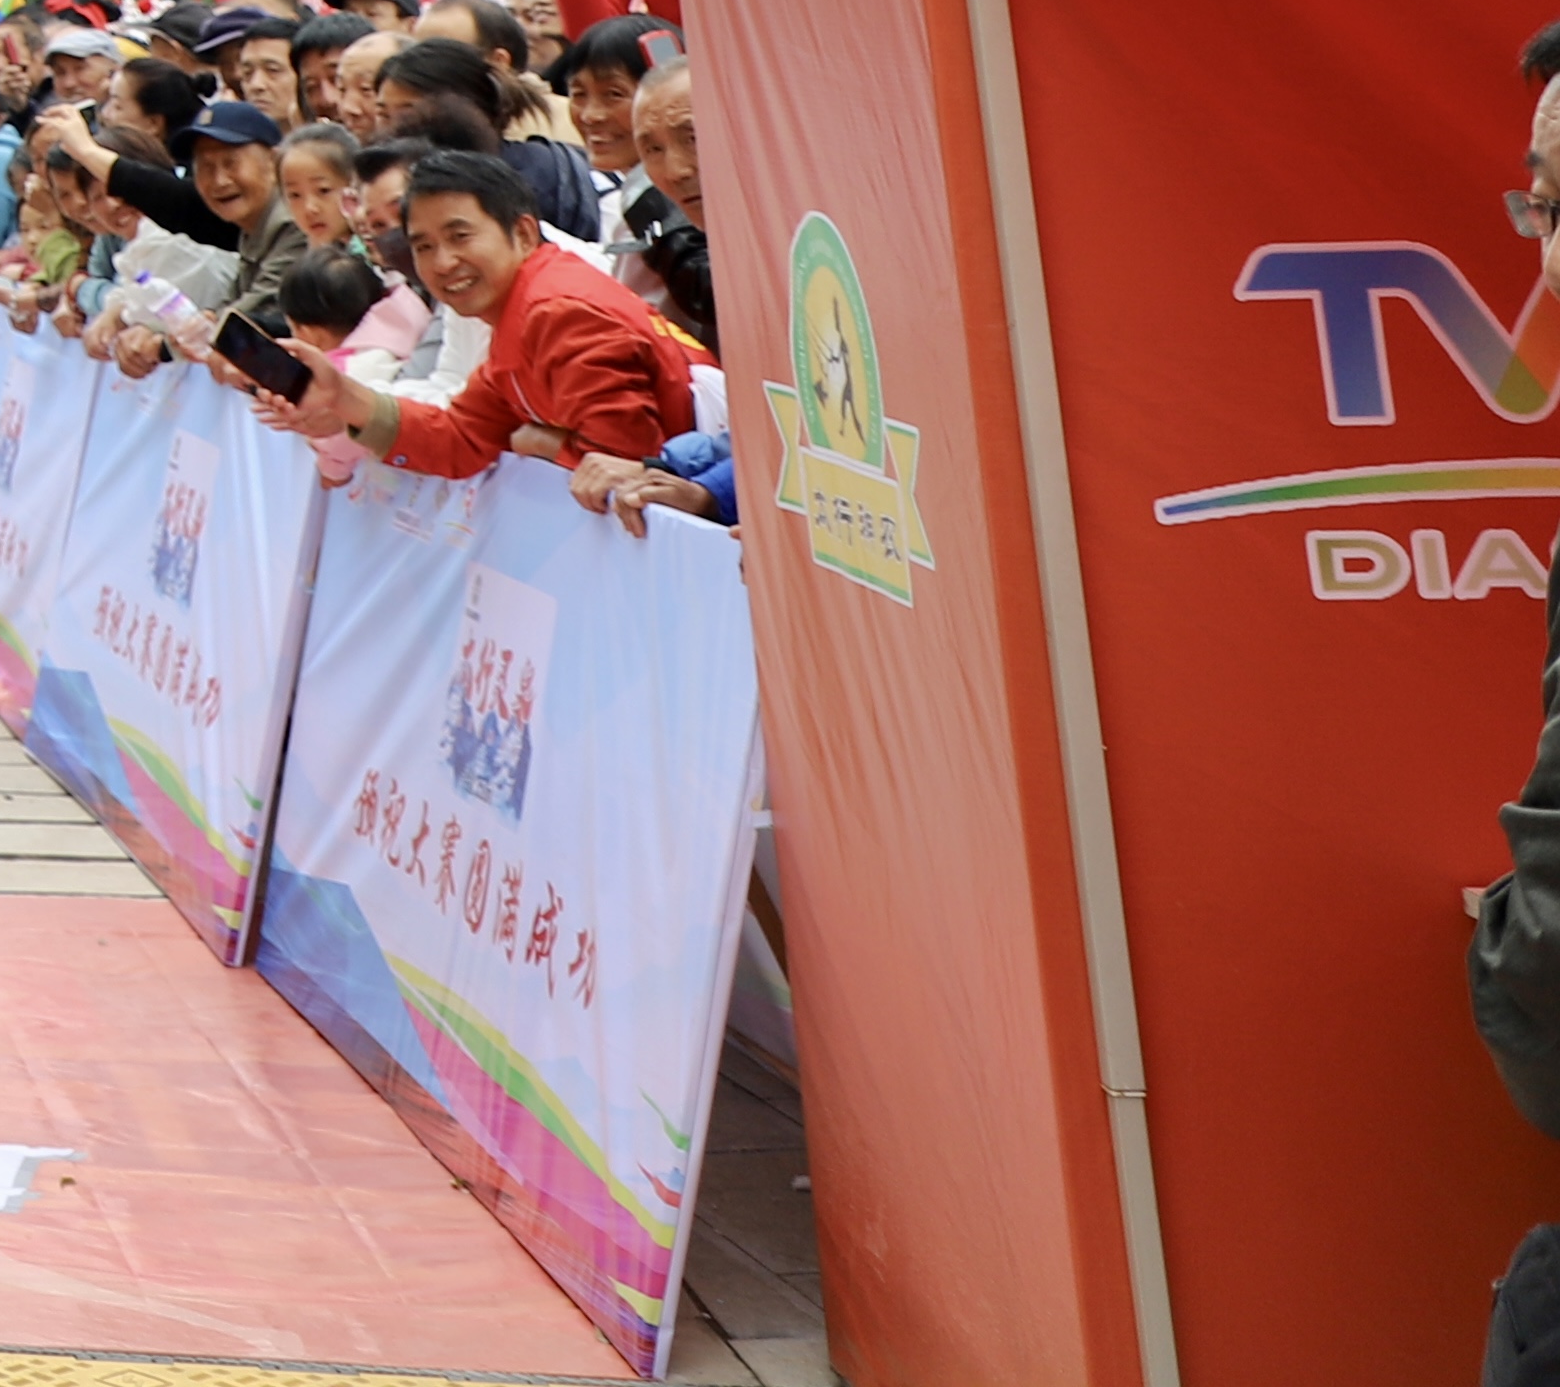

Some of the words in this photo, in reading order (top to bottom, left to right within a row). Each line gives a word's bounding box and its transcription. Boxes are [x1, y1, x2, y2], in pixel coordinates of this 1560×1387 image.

[352, 767, 600, 1012] 预祝大赛圆满成功
